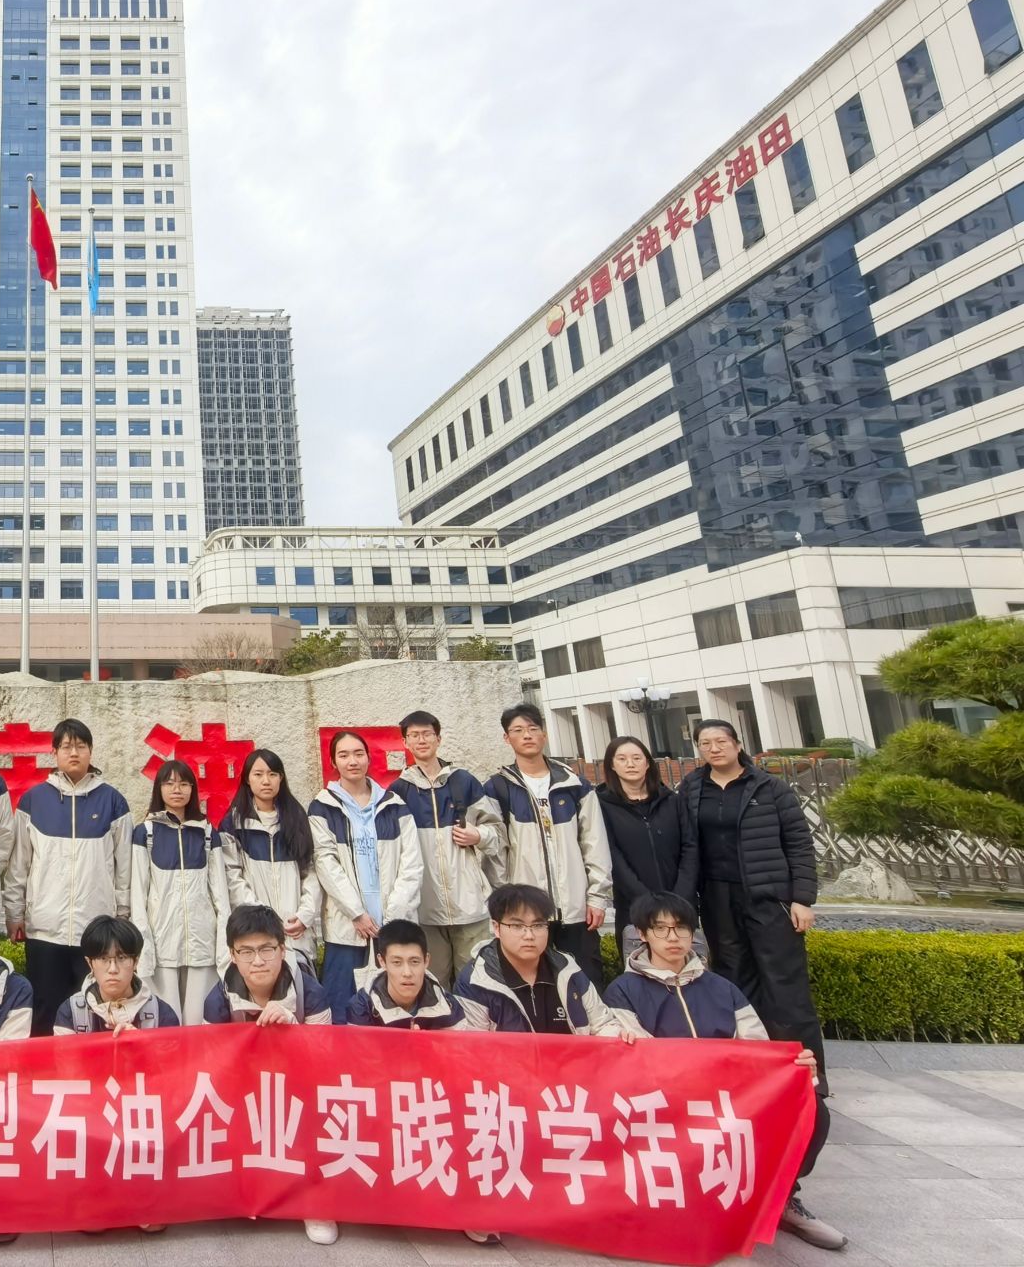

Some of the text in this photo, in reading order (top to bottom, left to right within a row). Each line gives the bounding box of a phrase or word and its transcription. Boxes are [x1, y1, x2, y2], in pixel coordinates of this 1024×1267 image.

[570, 113, 793, 316] 中国石油长庆油田
